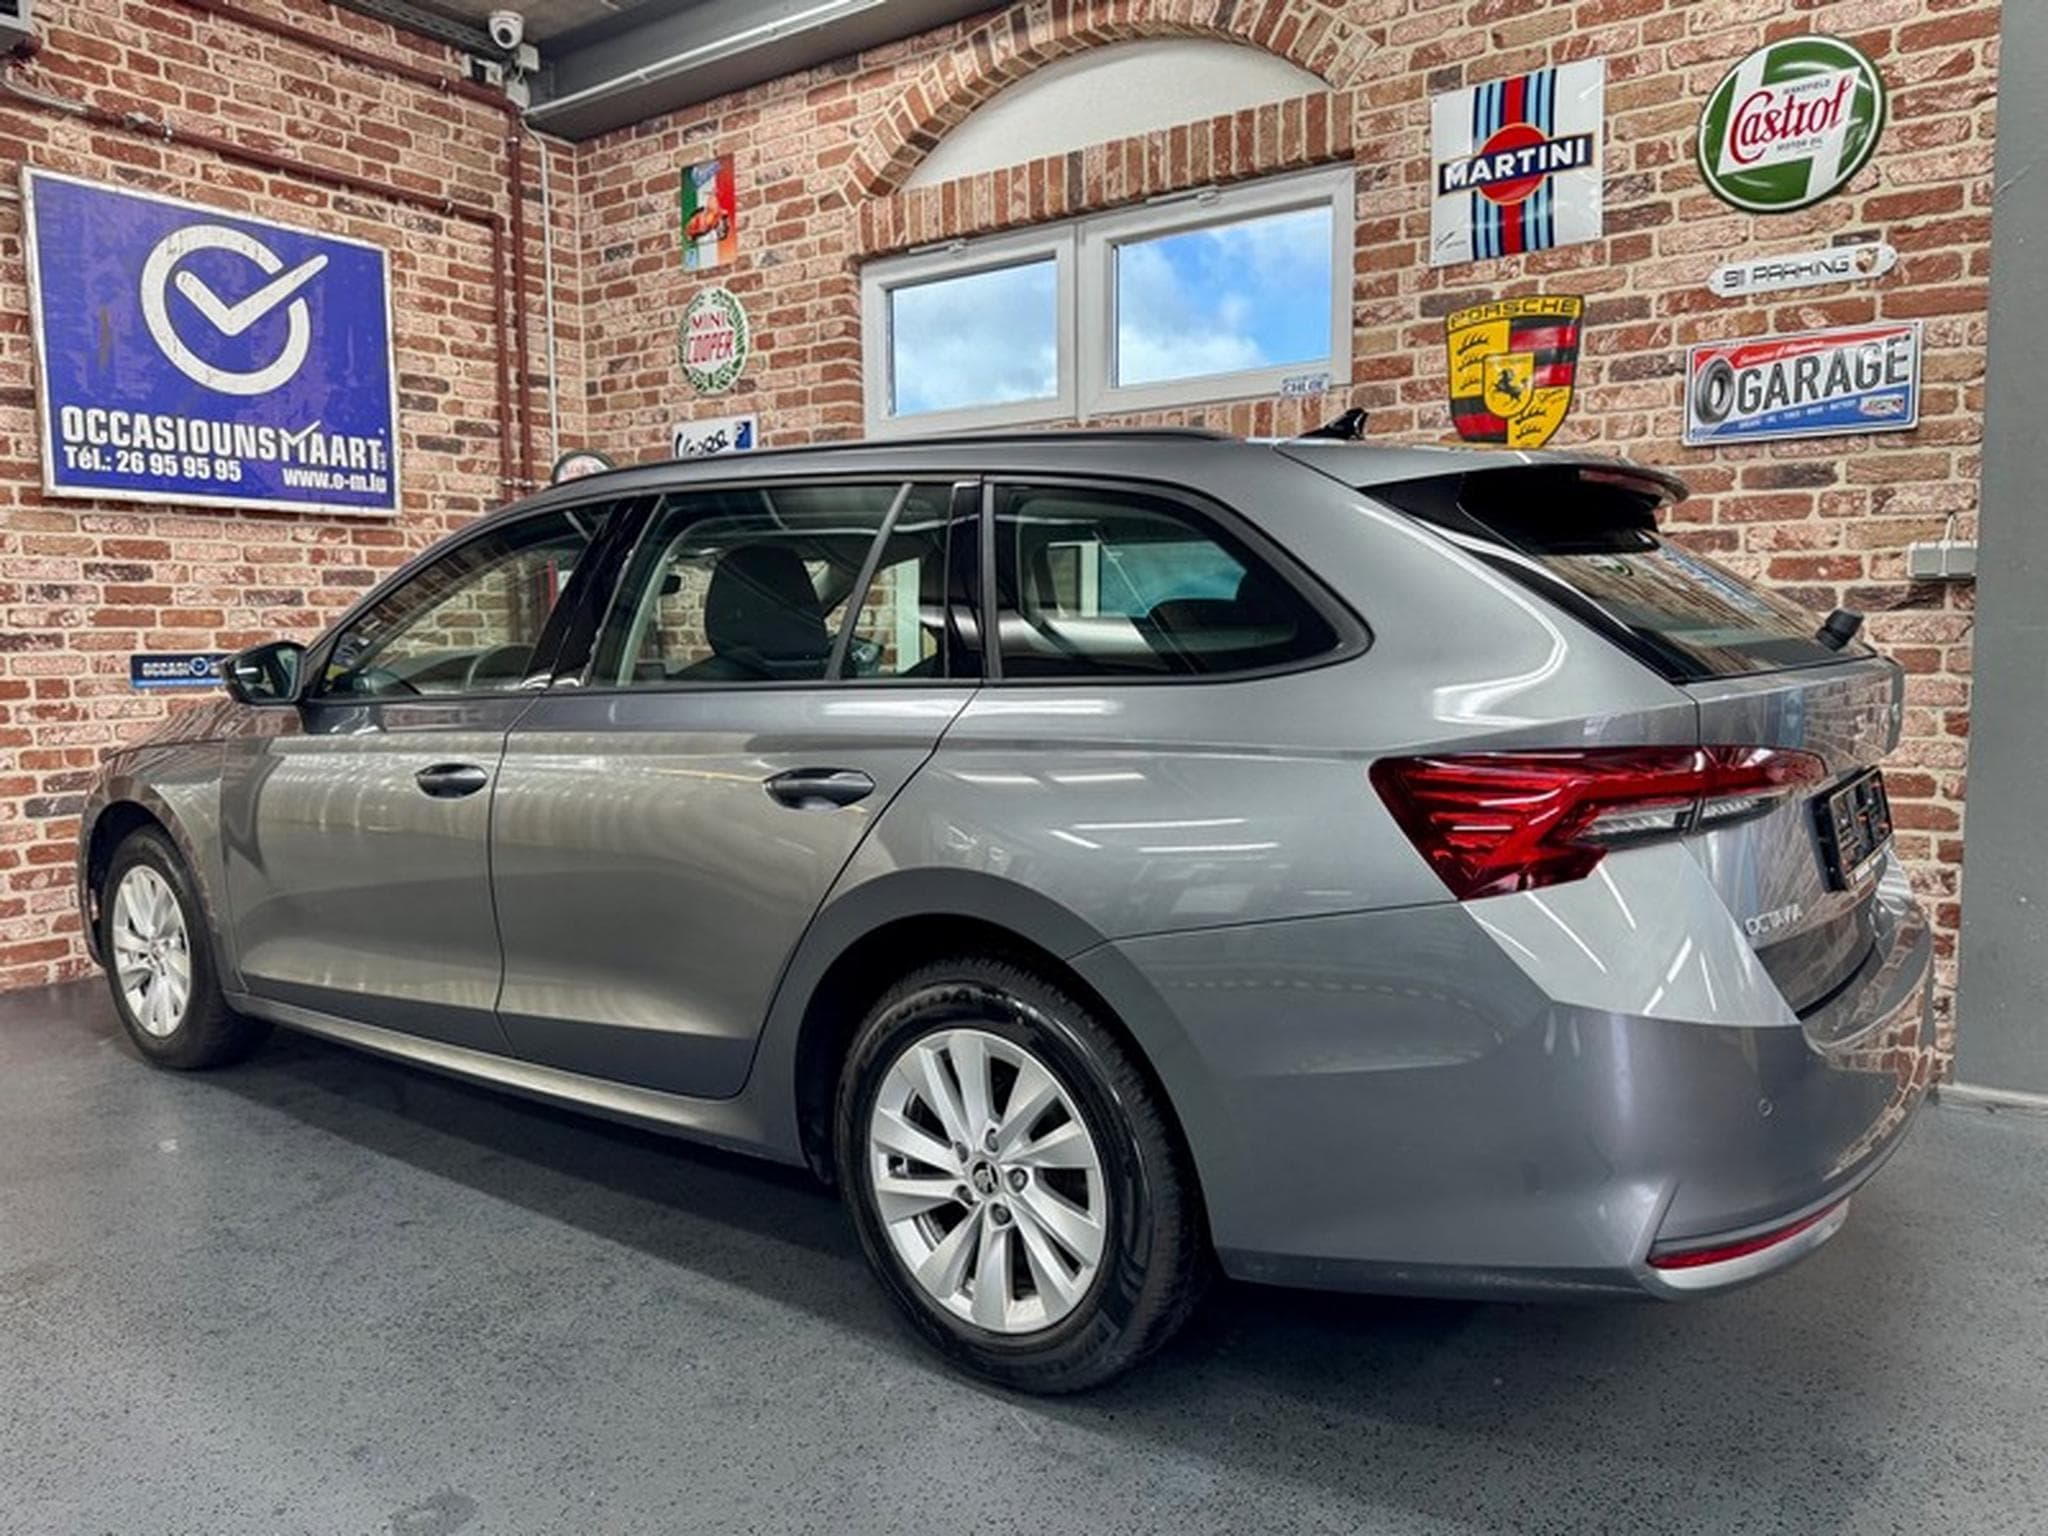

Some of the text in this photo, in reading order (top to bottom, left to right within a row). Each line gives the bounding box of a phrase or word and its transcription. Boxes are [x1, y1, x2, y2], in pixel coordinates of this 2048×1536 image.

[1729, 74, 1853, 164] Castrol
[1445, 138, 1585, 190] MARTINI
[1752, 255, 1849, 283] PARKING
[692, 310, 727, 329] MINI
[1450, 299, 1577, 328] PORSCHE
[687, 330, 734, 364] COOPER
[1737, 334, 1911, 415] GARAGE
[64, 446, 242, 482] Tél.: 26 95 95 95
[283, 467, 387, 493] www.o-m.lu
